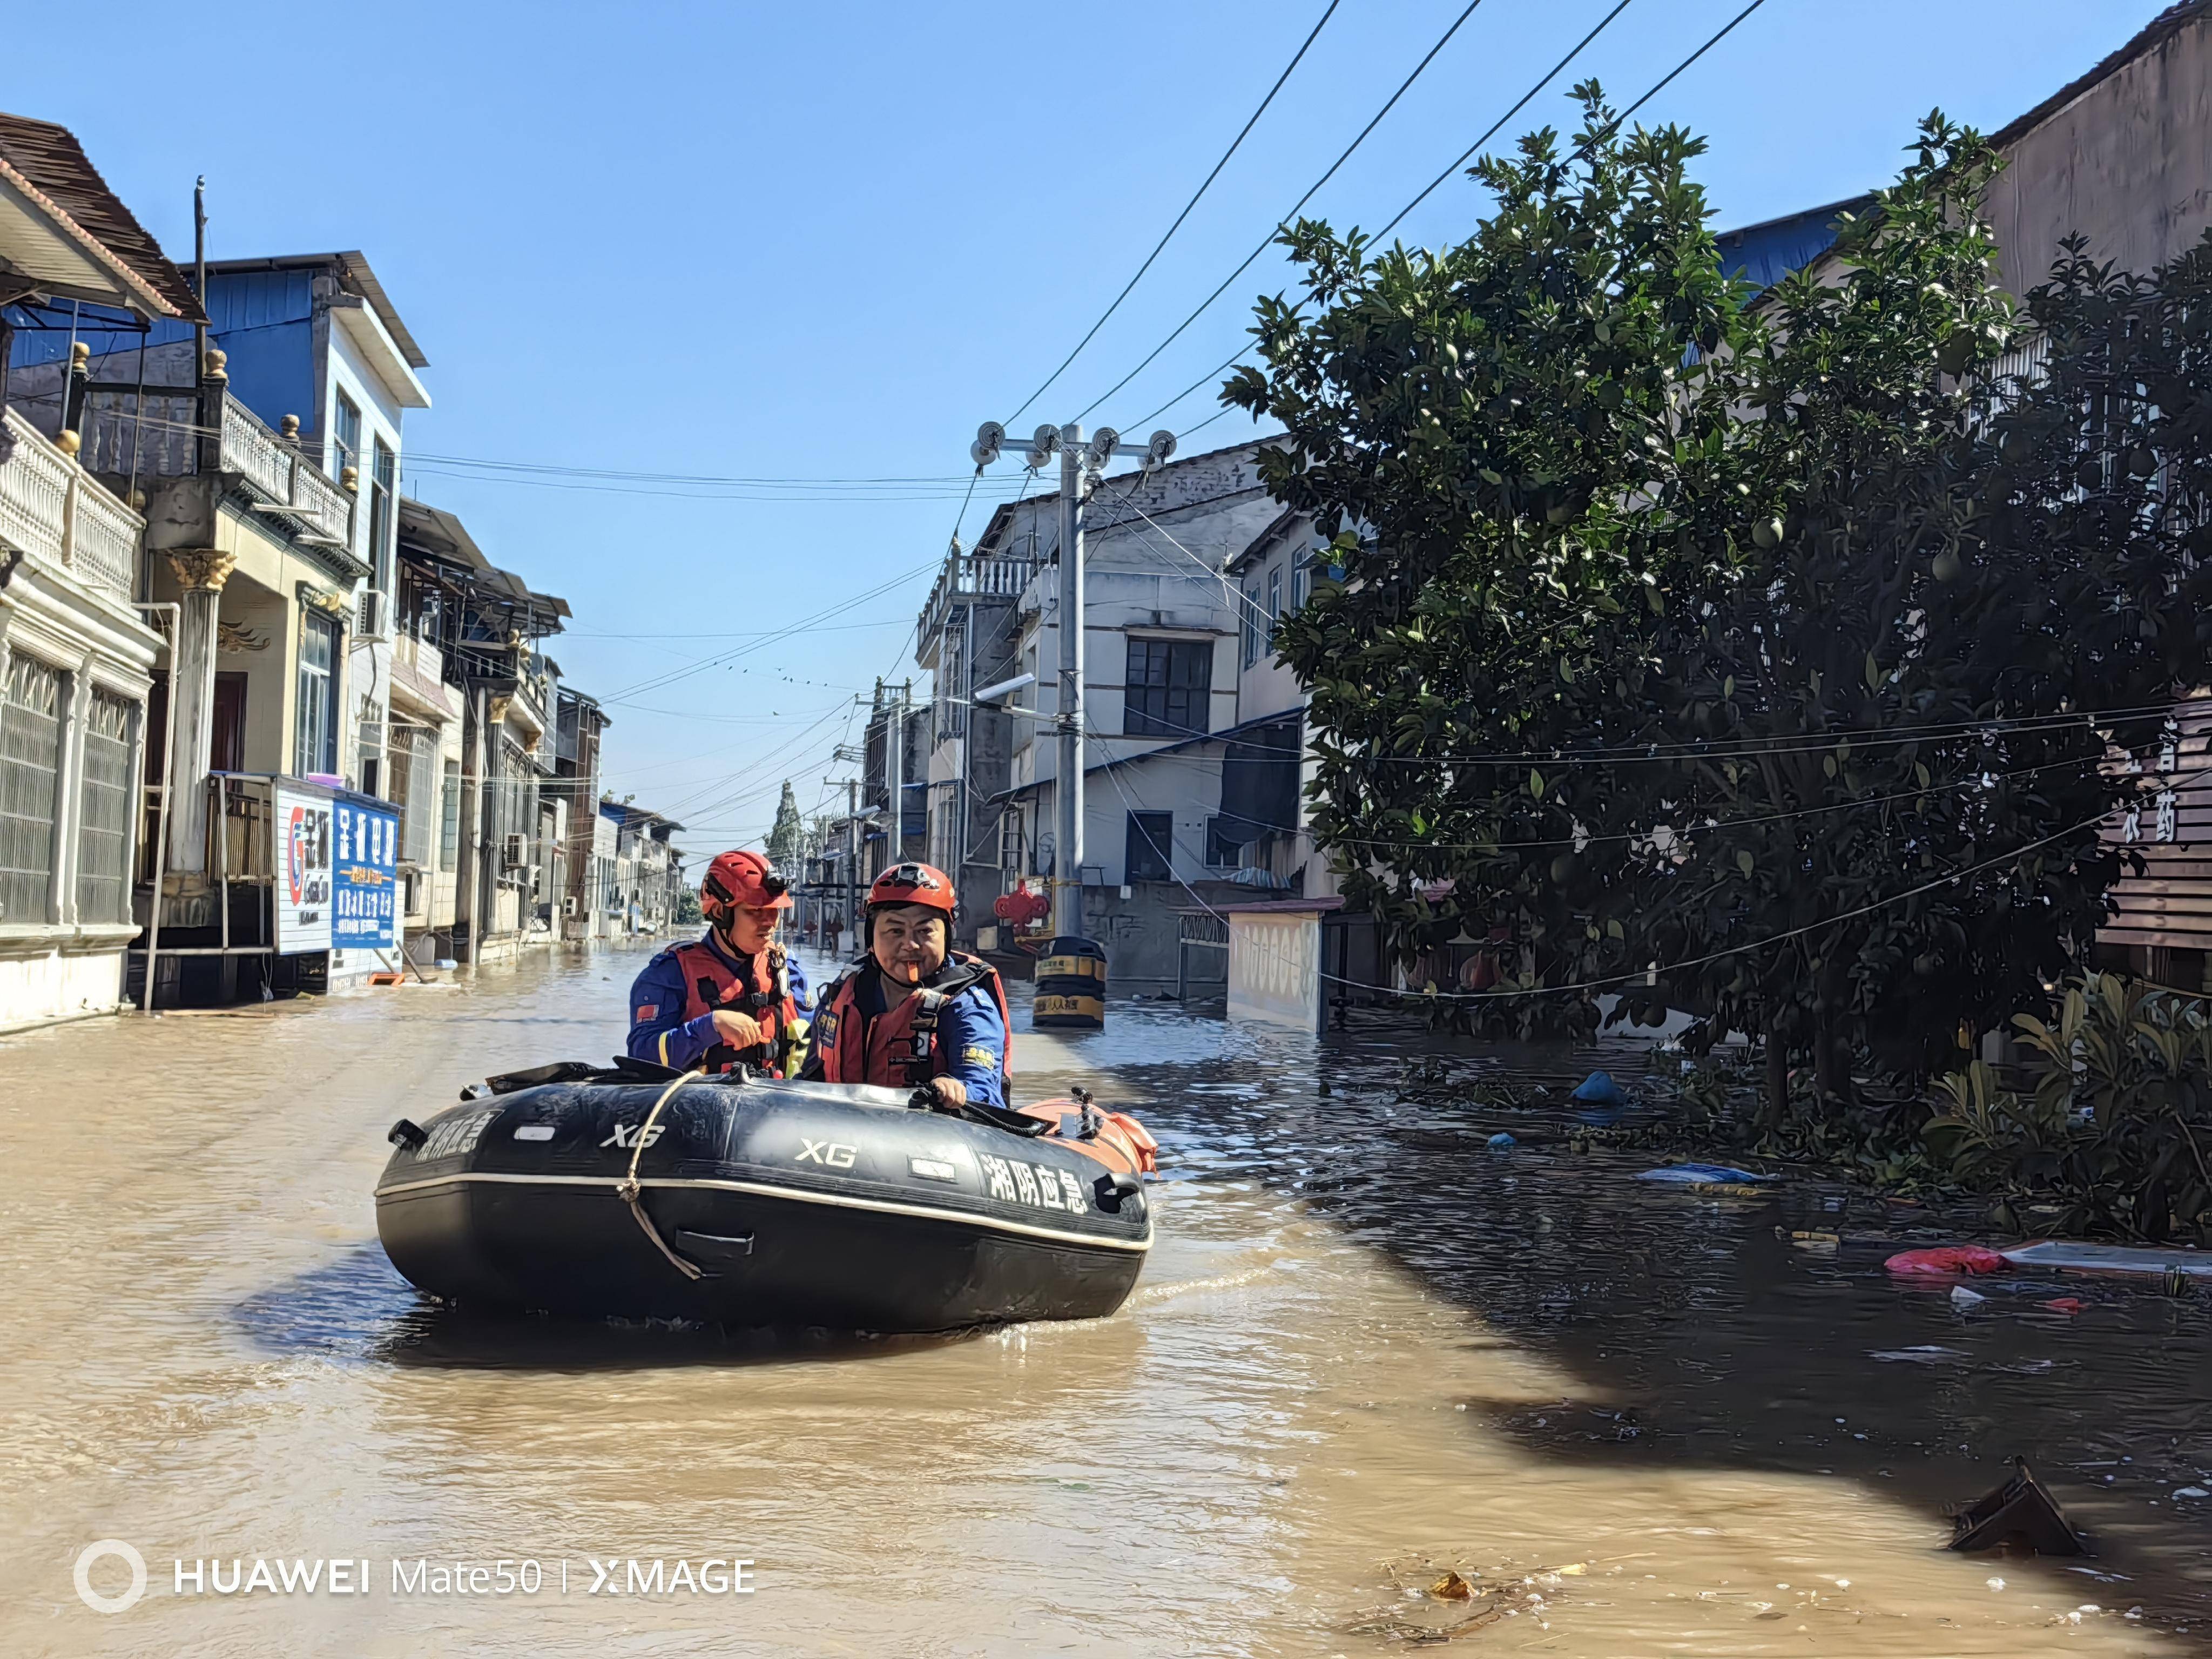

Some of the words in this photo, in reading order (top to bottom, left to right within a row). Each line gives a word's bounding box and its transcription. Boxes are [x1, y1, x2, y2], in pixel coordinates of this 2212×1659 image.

[599, 1124, 666, 1148] XG
[794, 1137, 858, 1168] XG
[981, 1154, 1089, 1215] 湘阴应急
